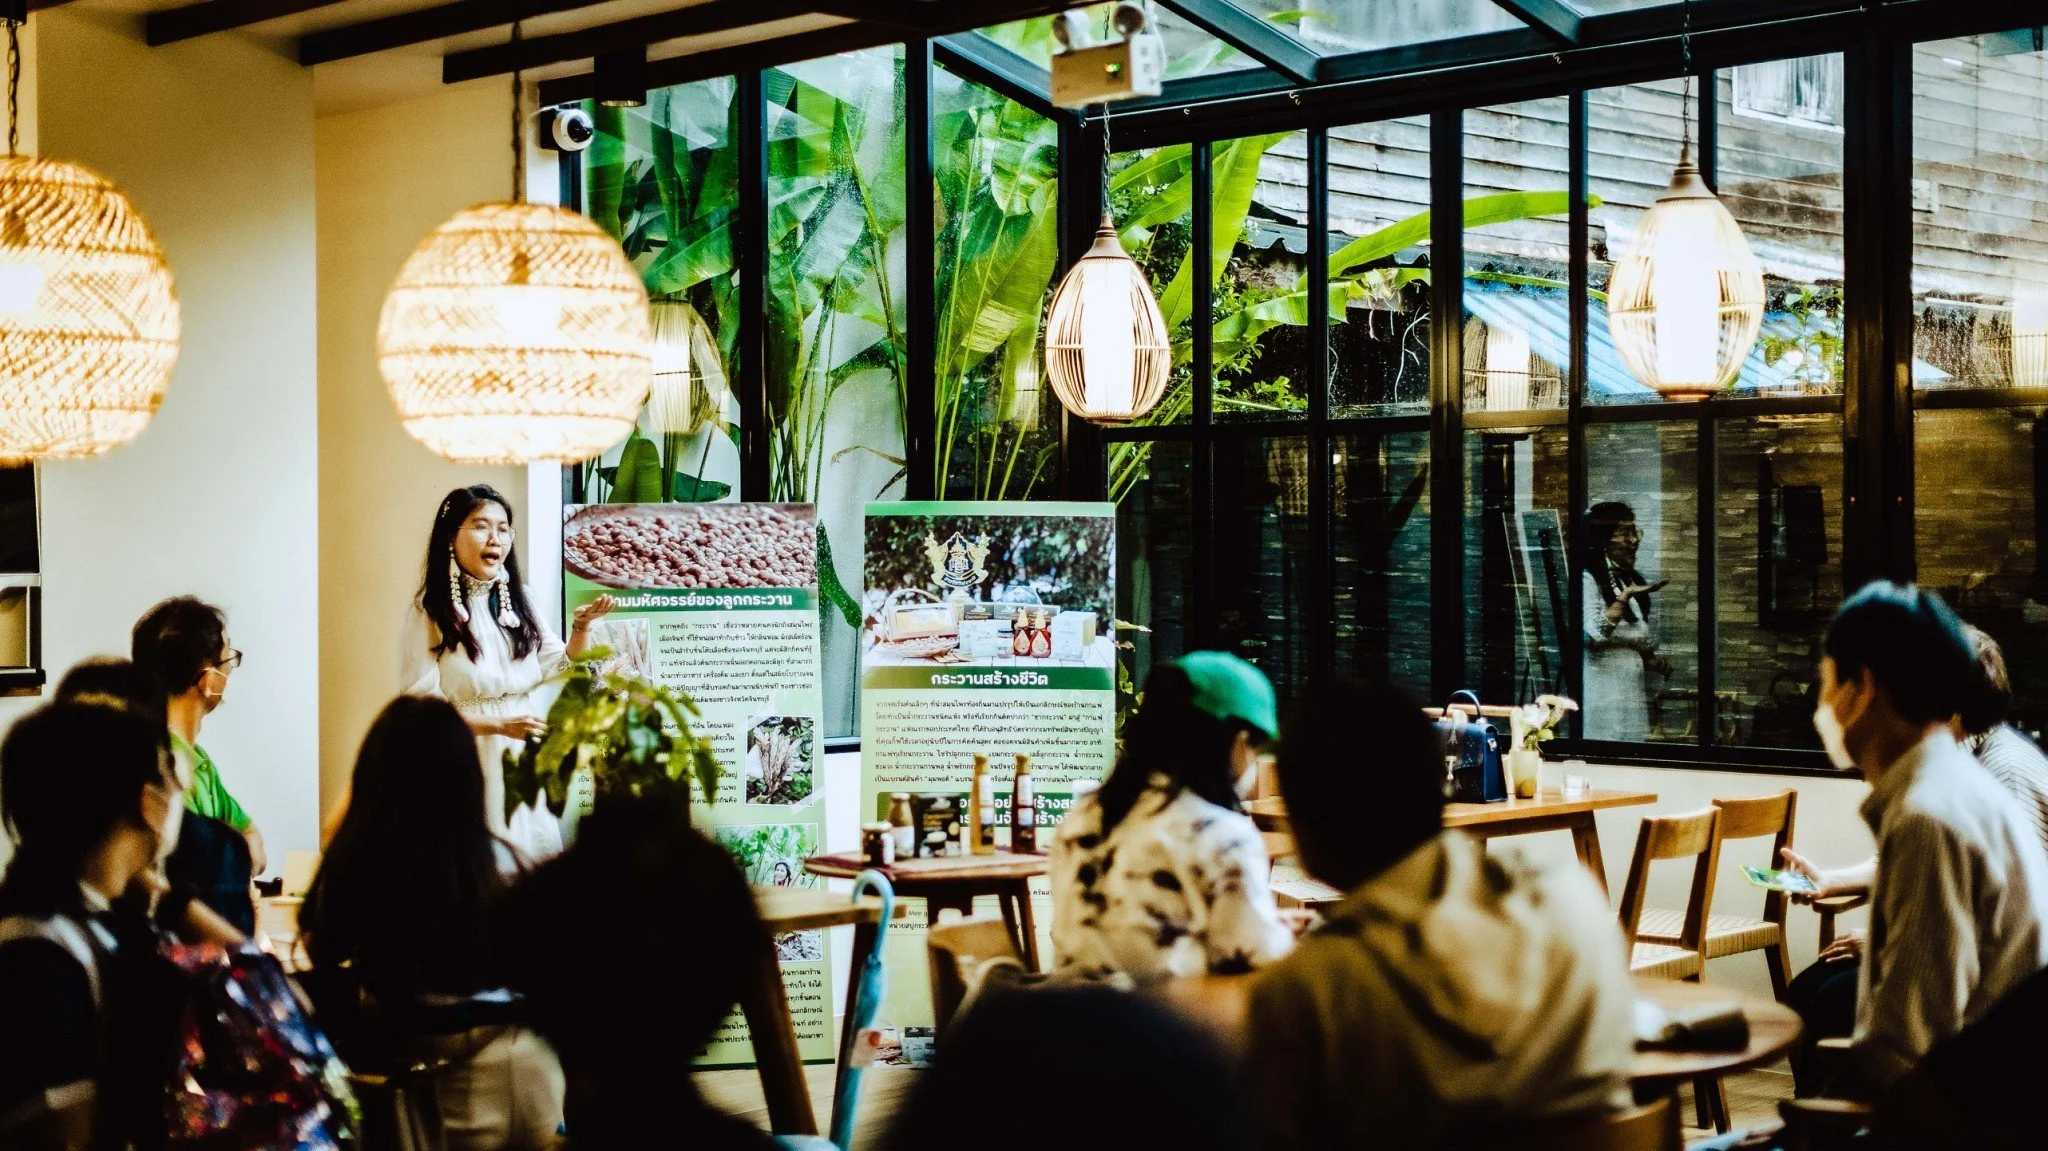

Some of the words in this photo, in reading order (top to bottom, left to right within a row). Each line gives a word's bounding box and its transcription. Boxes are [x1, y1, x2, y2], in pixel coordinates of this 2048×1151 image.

[611, 593, 793, 610] ามมหัศจรรย์ของลูกกระวาน
[930, 669, 1049, 686] กระวานสร้างชีวิต
